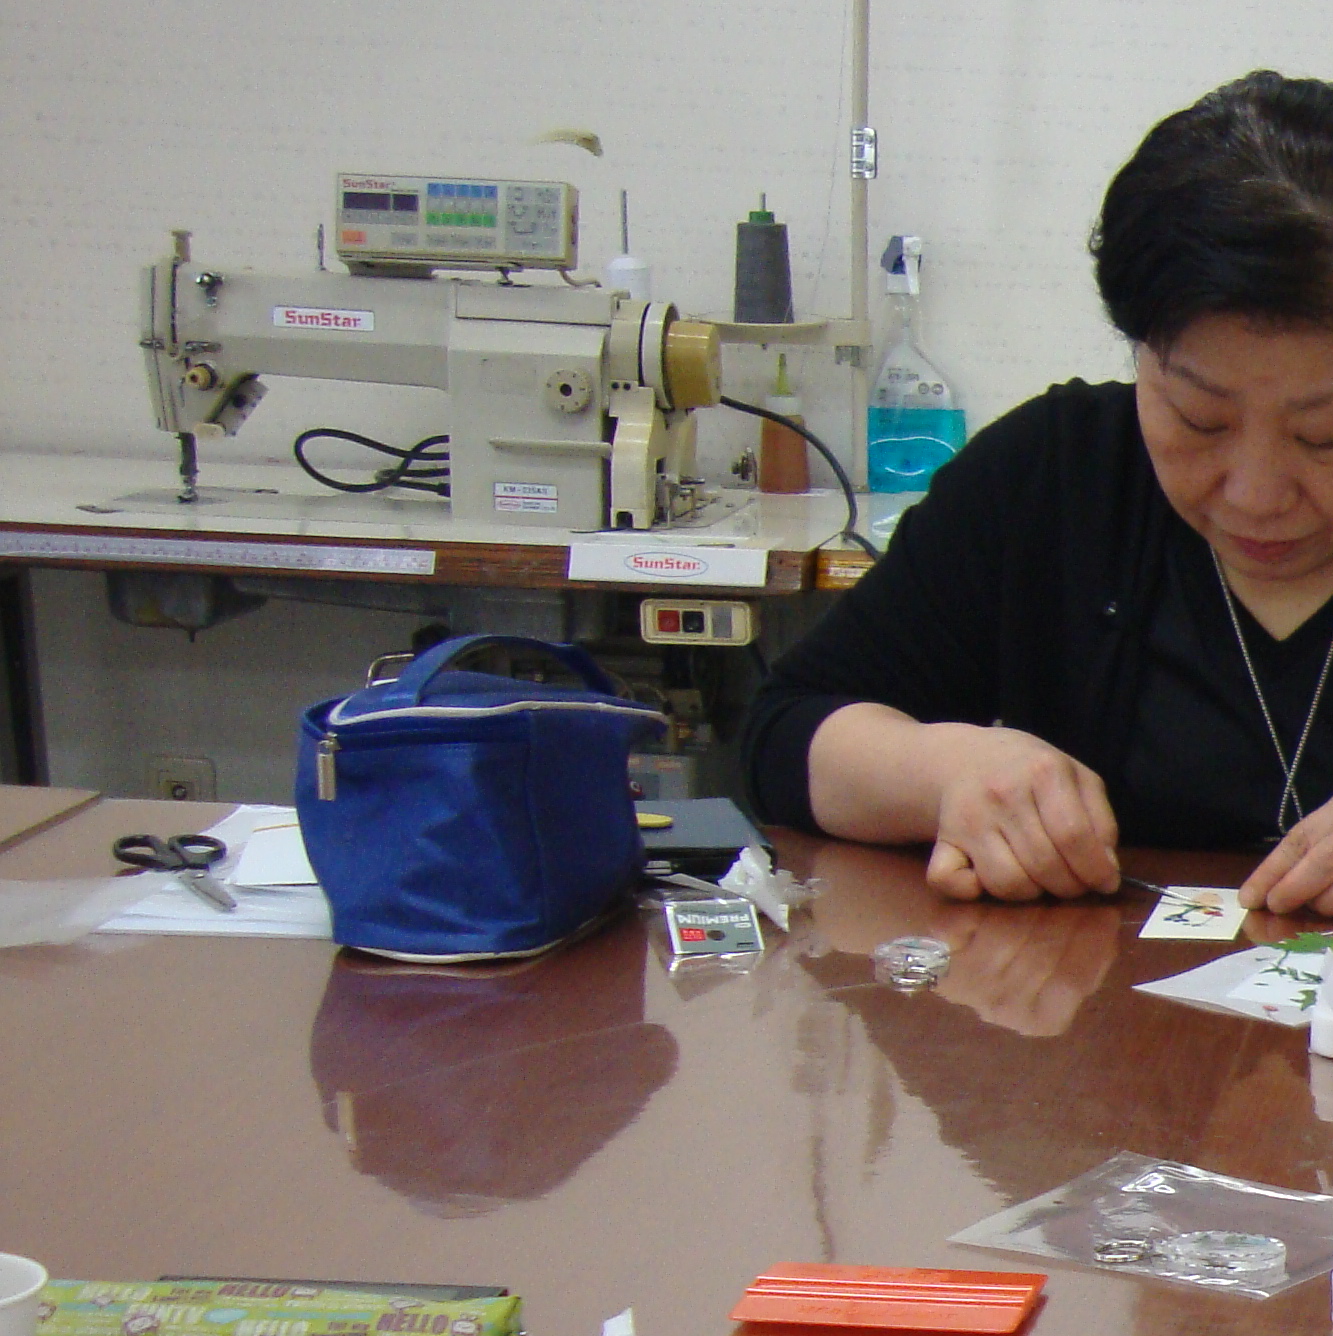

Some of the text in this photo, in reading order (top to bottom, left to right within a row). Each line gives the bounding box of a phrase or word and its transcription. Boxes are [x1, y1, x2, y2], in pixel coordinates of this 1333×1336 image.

[284, 310, 362, 328] SunStar
[632, 556, 700, 570] SunStar
[676, 913, 750, 925] PREMIUM
[376, 1313, 450, 1335] HELLO
